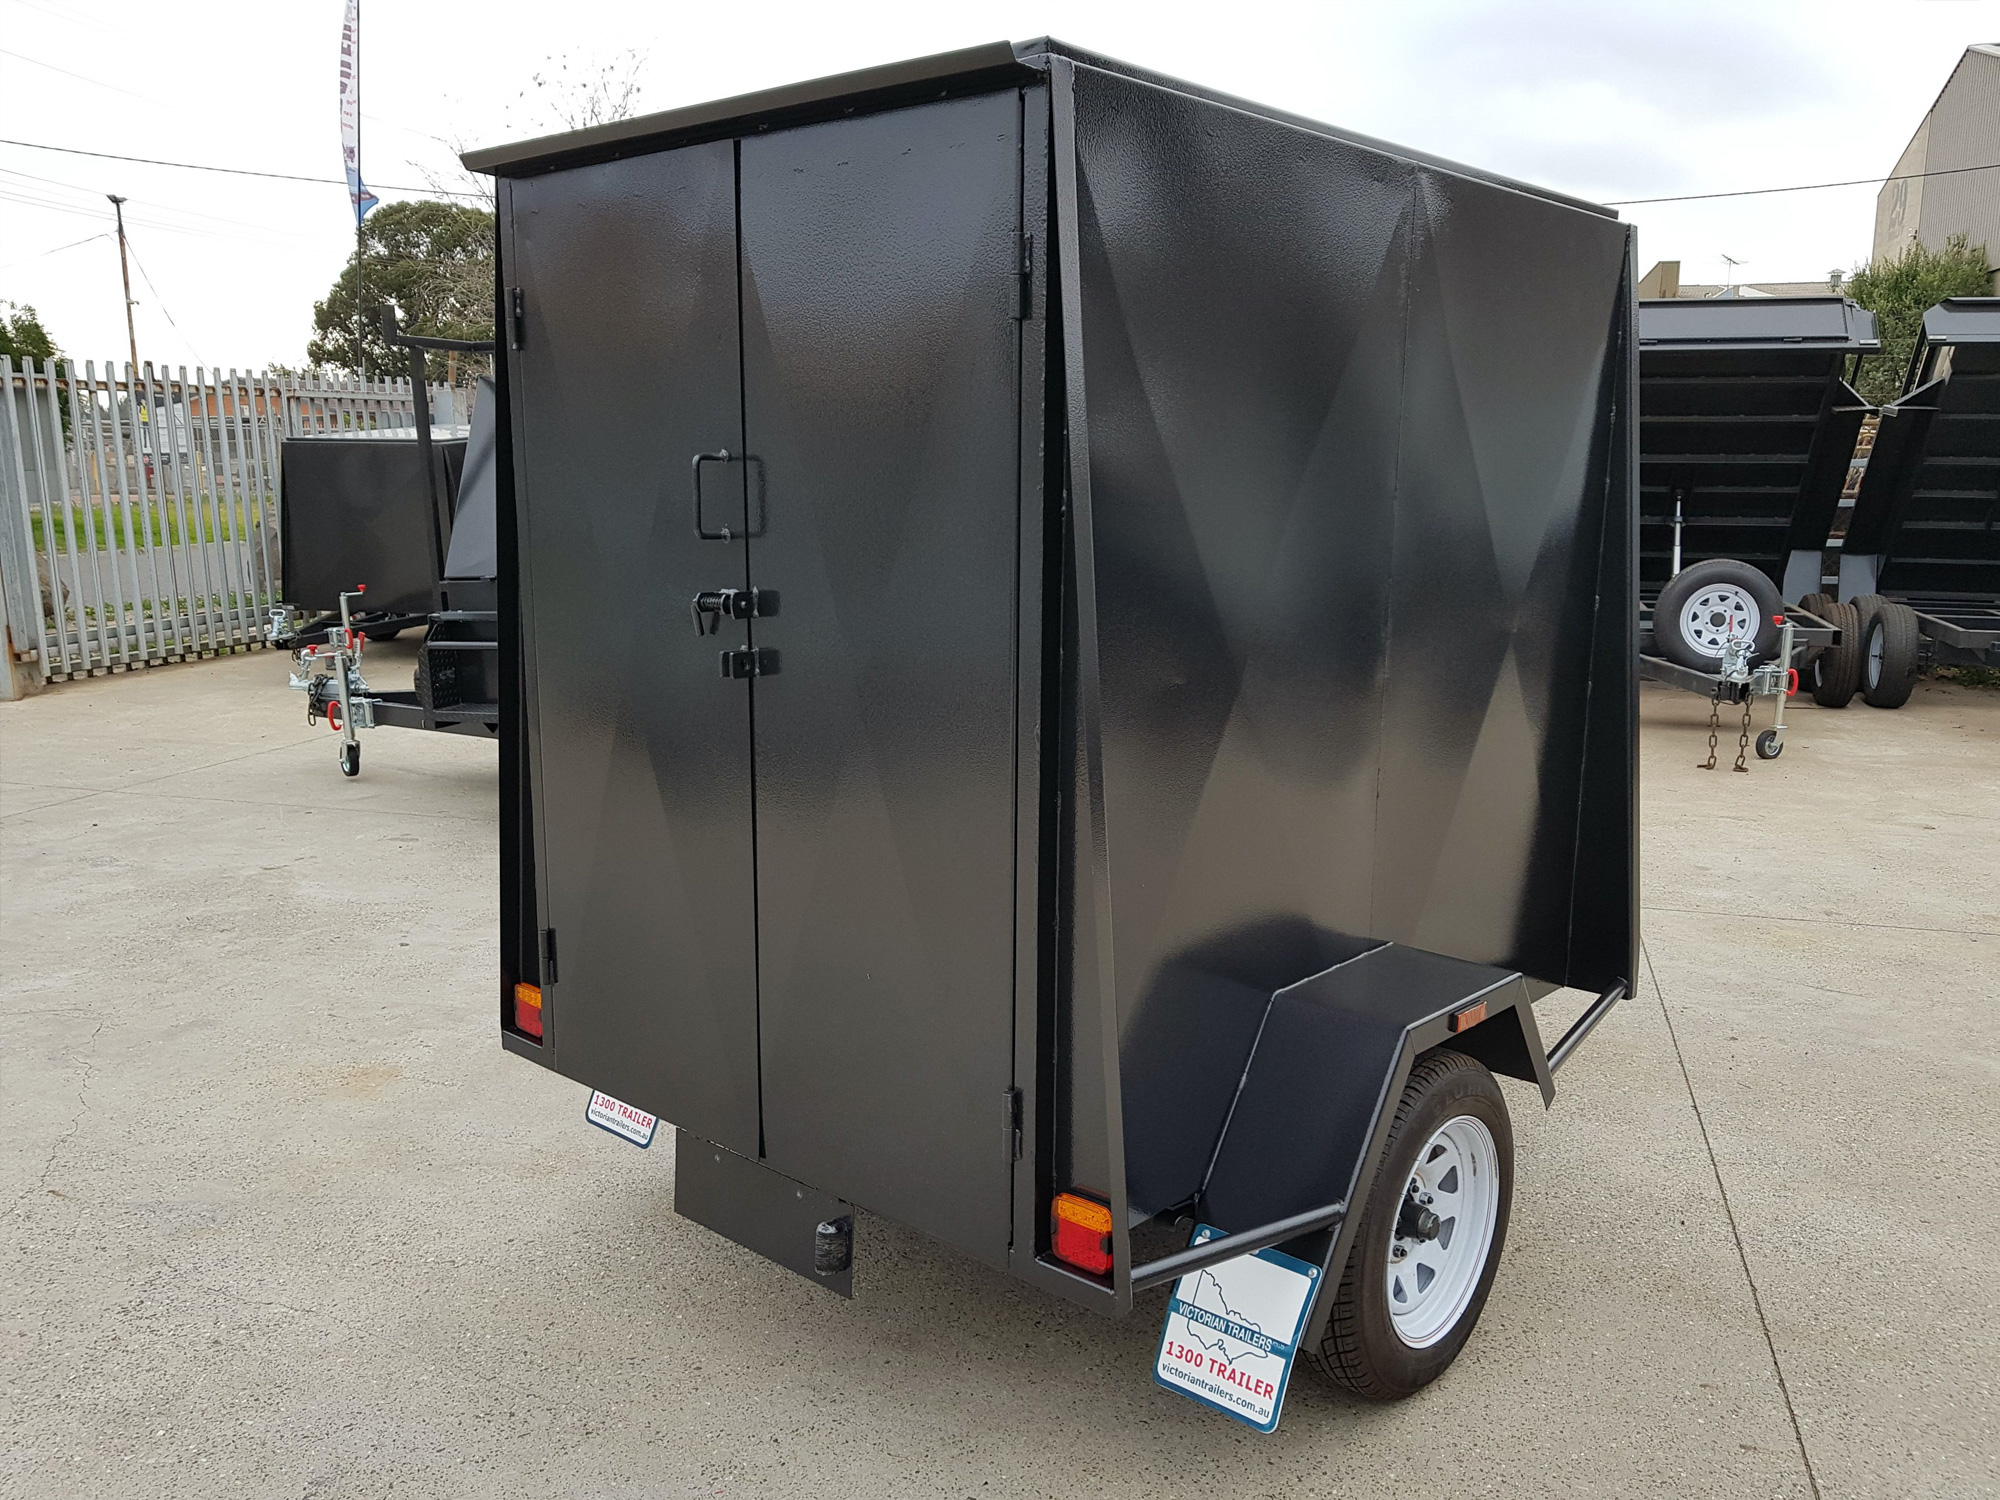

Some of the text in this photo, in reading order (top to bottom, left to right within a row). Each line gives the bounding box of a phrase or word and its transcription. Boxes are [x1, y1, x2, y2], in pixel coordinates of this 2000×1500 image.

[590, 1107, 649, 1140] victoriantrailers.com.au
[593, 1094, 653, 1130] 1300 TRAILER
[1178, 1301, 1273, 1351] VICTORIAN TRAILERS
[1161, 1362, 1271, 1419] victoriantrailers.com.au
[1165, 1340, 1275, 1401] 1300 TRAILER
